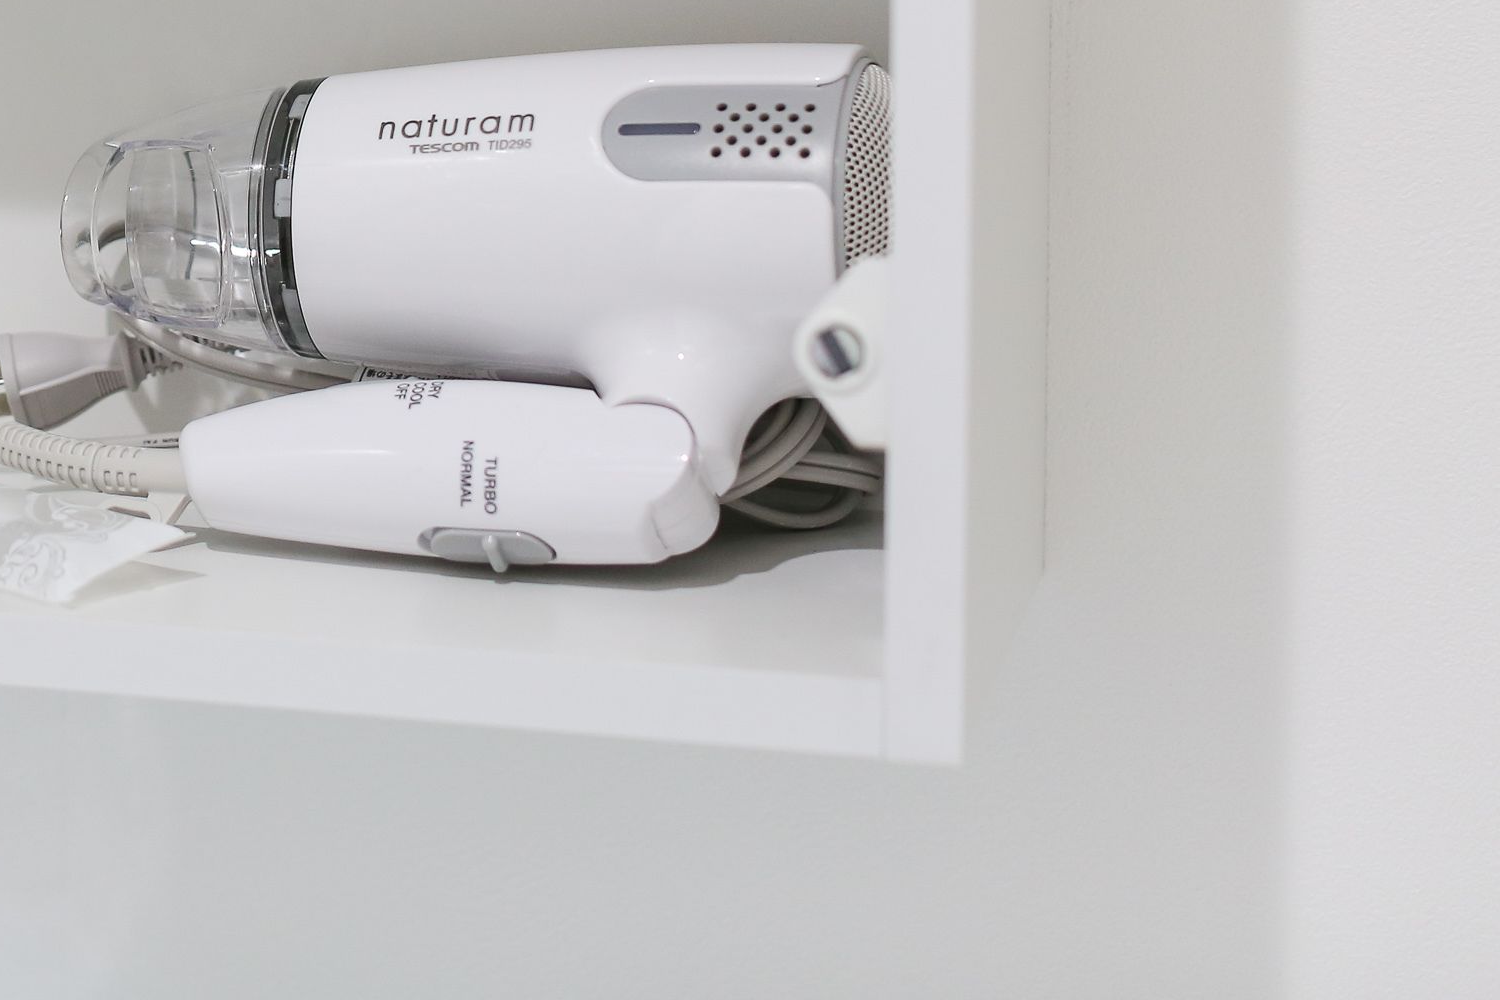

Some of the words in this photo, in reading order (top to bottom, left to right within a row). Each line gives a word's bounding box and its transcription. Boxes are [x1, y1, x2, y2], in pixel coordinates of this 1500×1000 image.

[378, 113, 536, 140] naturam
[409, 141, 480, 154] TESCOM
[487, 138, 533, 151] TID295
[394, 382, 410, 400] OFF
[408, 381, 427, 410] COOL
[427, 381, 444, 399] DRY
[460, 440, 475, 507] NORMAL
[483, 456, 498, 515] TURBO
